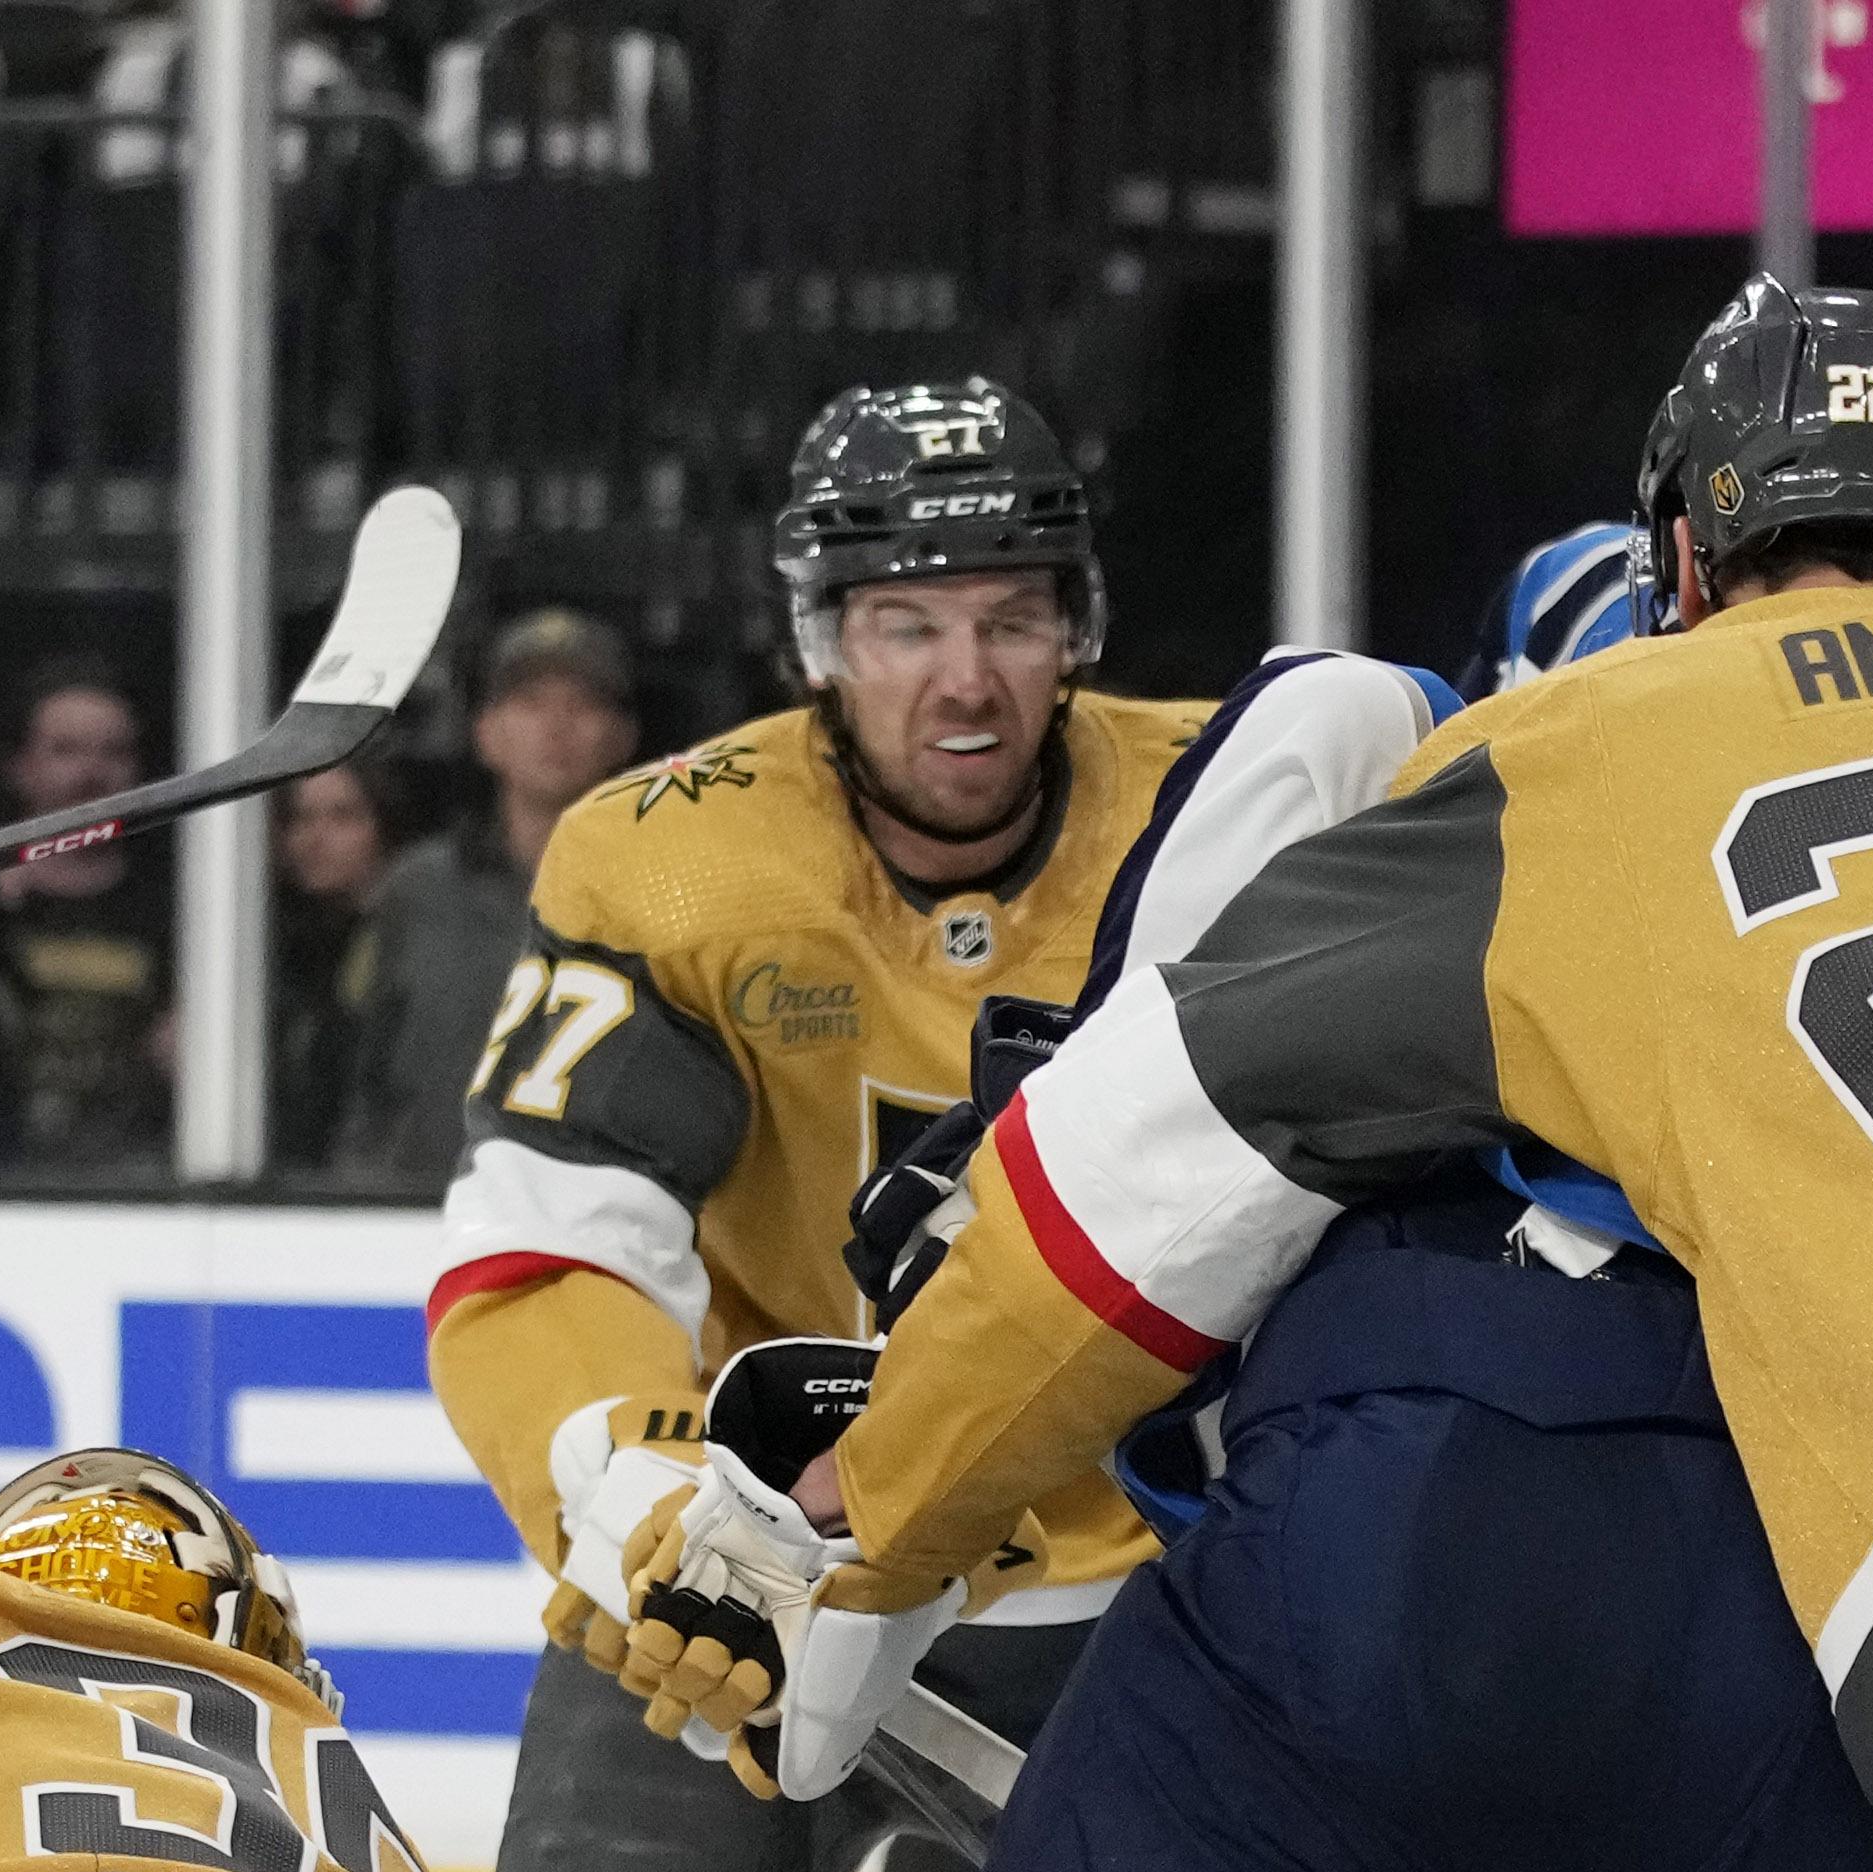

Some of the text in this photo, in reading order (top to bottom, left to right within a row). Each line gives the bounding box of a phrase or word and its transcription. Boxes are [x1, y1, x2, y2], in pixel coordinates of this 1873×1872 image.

[907, 491, 1016, 521] CCM
[25, 823, 118, 862] CCM
[735, 961, 861, 1028] Circa
[780, 1014, 861, 1042] SPORTS
[803, 1378, 876, 1395] CCM
